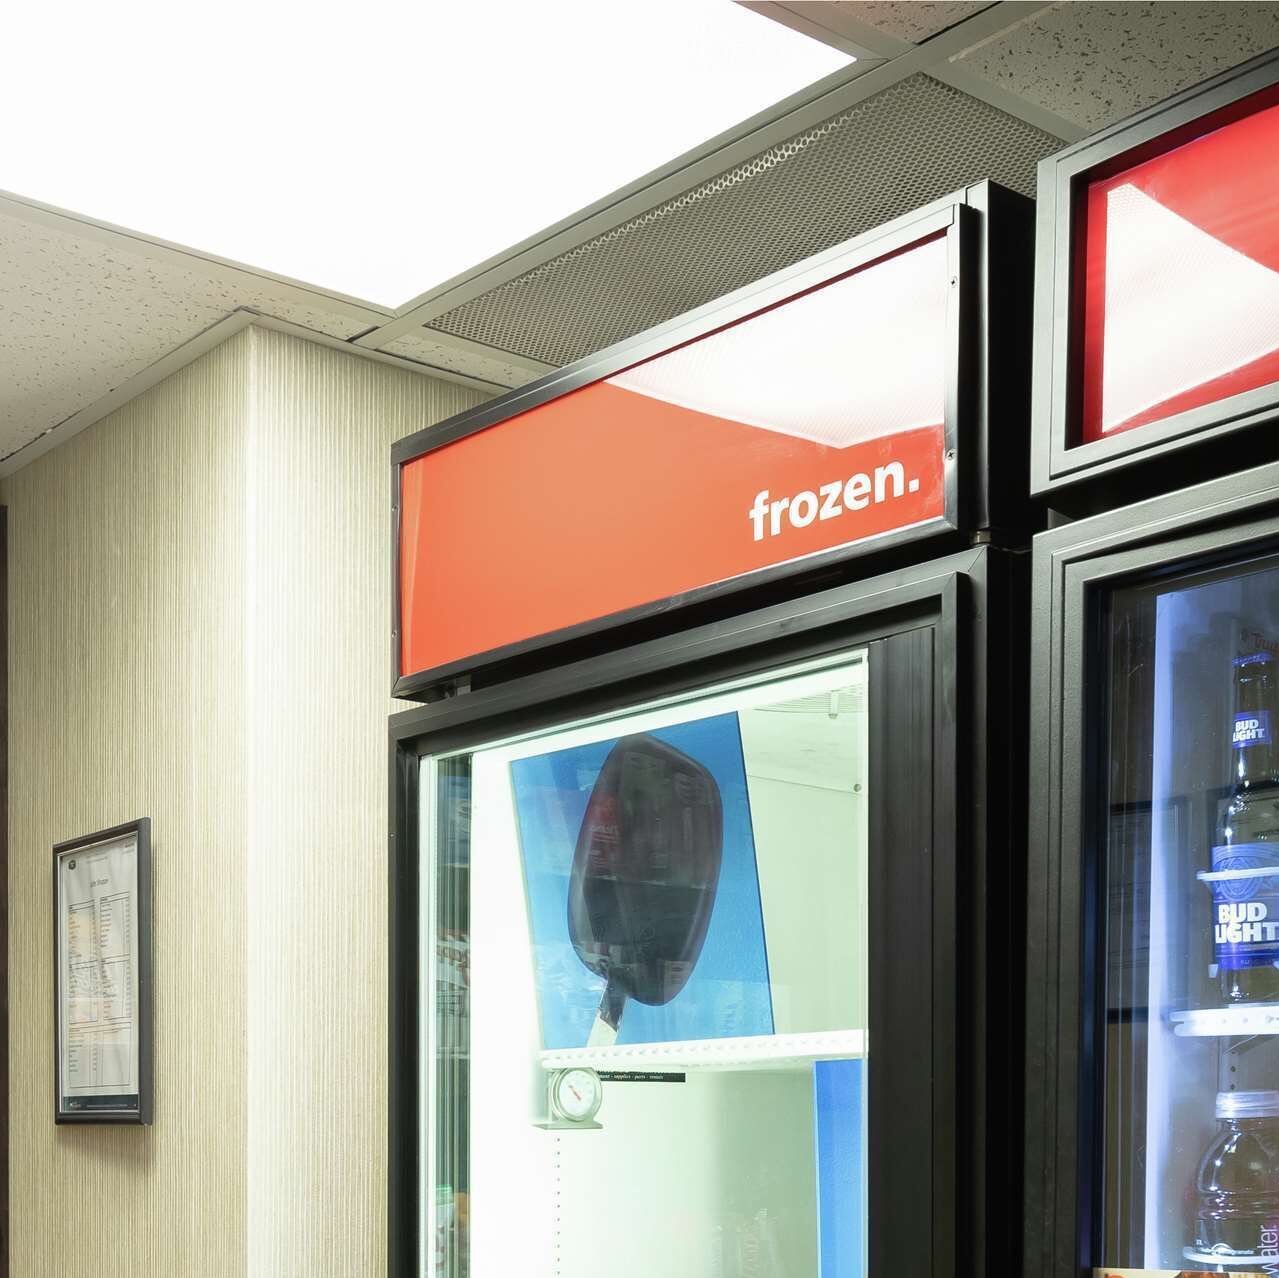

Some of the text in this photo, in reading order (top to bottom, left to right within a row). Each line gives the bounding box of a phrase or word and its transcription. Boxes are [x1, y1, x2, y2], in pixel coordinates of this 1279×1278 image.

[749, 461, 919, 541] frozen.
[1235, 718, 1259, 731] BUD
[1218, 902, 1267, 924] BUD
[1215, 922, 1279, 944] LIGHT
